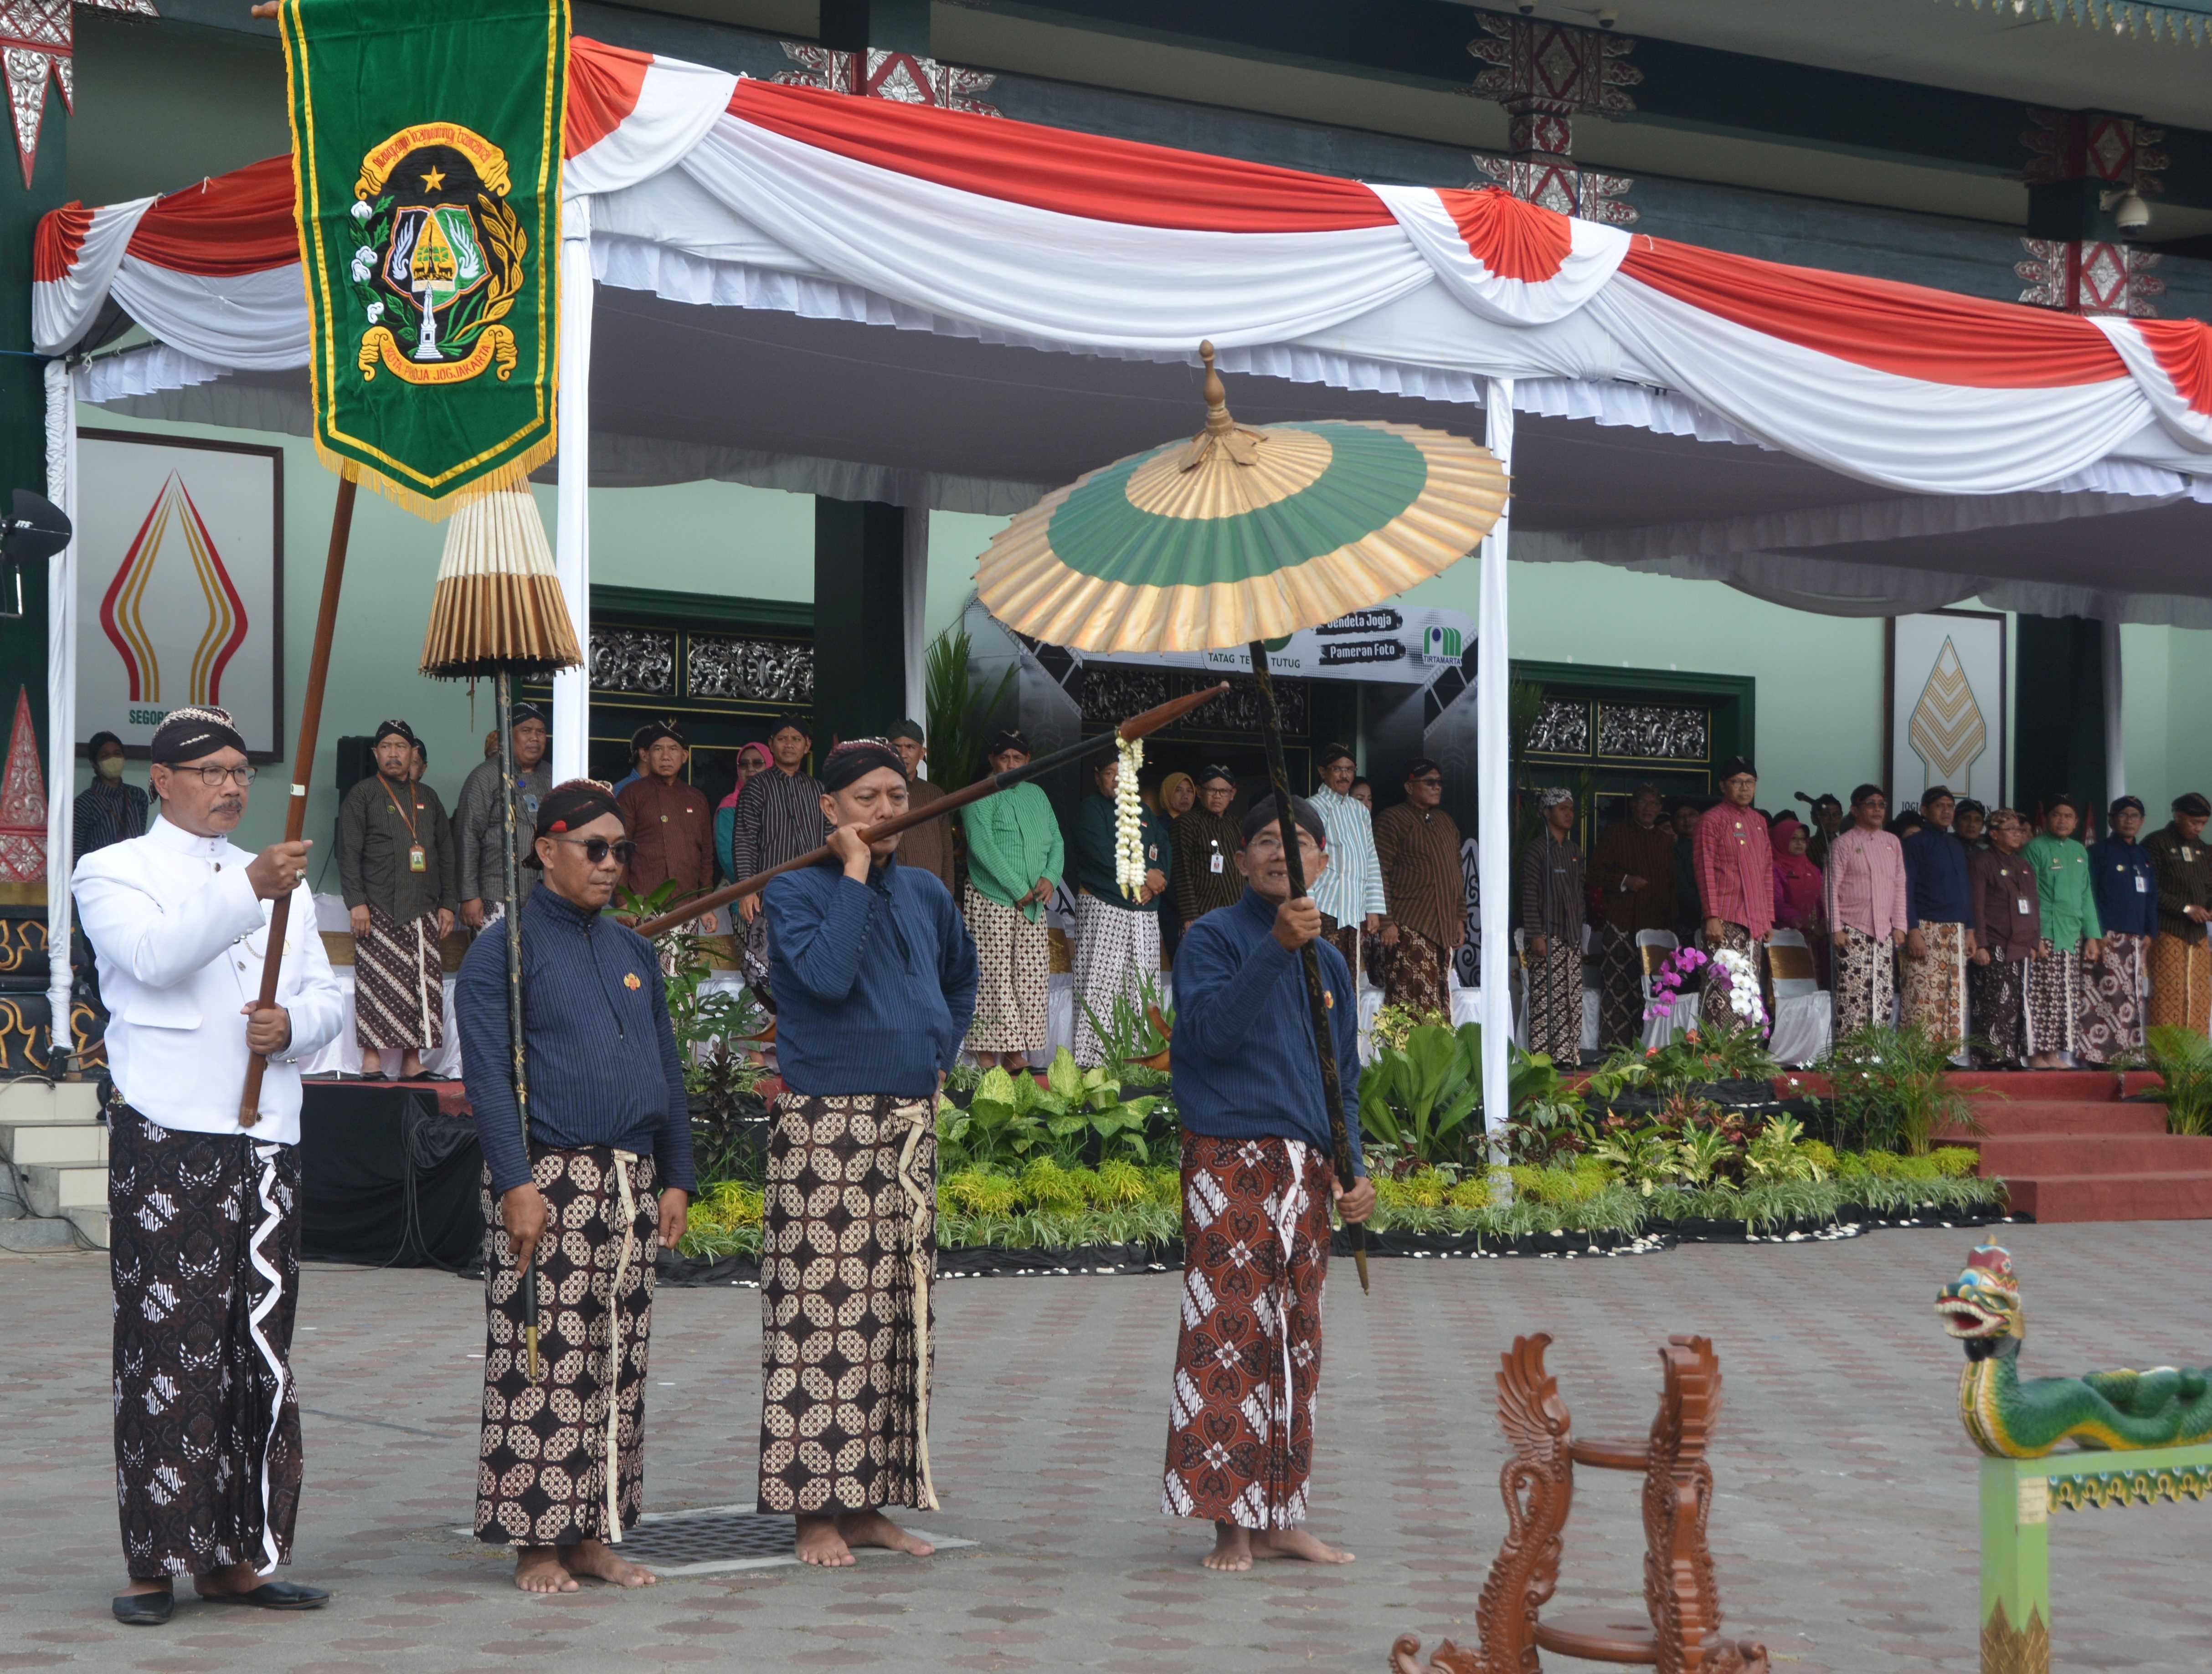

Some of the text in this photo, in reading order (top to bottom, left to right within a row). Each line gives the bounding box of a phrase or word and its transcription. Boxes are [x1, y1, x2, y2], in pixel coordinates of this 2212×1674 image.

[384, 347, 402, 372] KOTA
[433, 344, 491, 381] JOGJAKARTA
[1366, 613, 1392, 629] Jogja
[1330, 643, 1395, 658] Pameran Foto
[1208, 653, 1235, 663] TATAG
[1271, 657, 1300, 668] TUTUG
[1423, 656, 1461, 665] TIRTAMARTA
[129, 709, 170, 725] SEGOR
